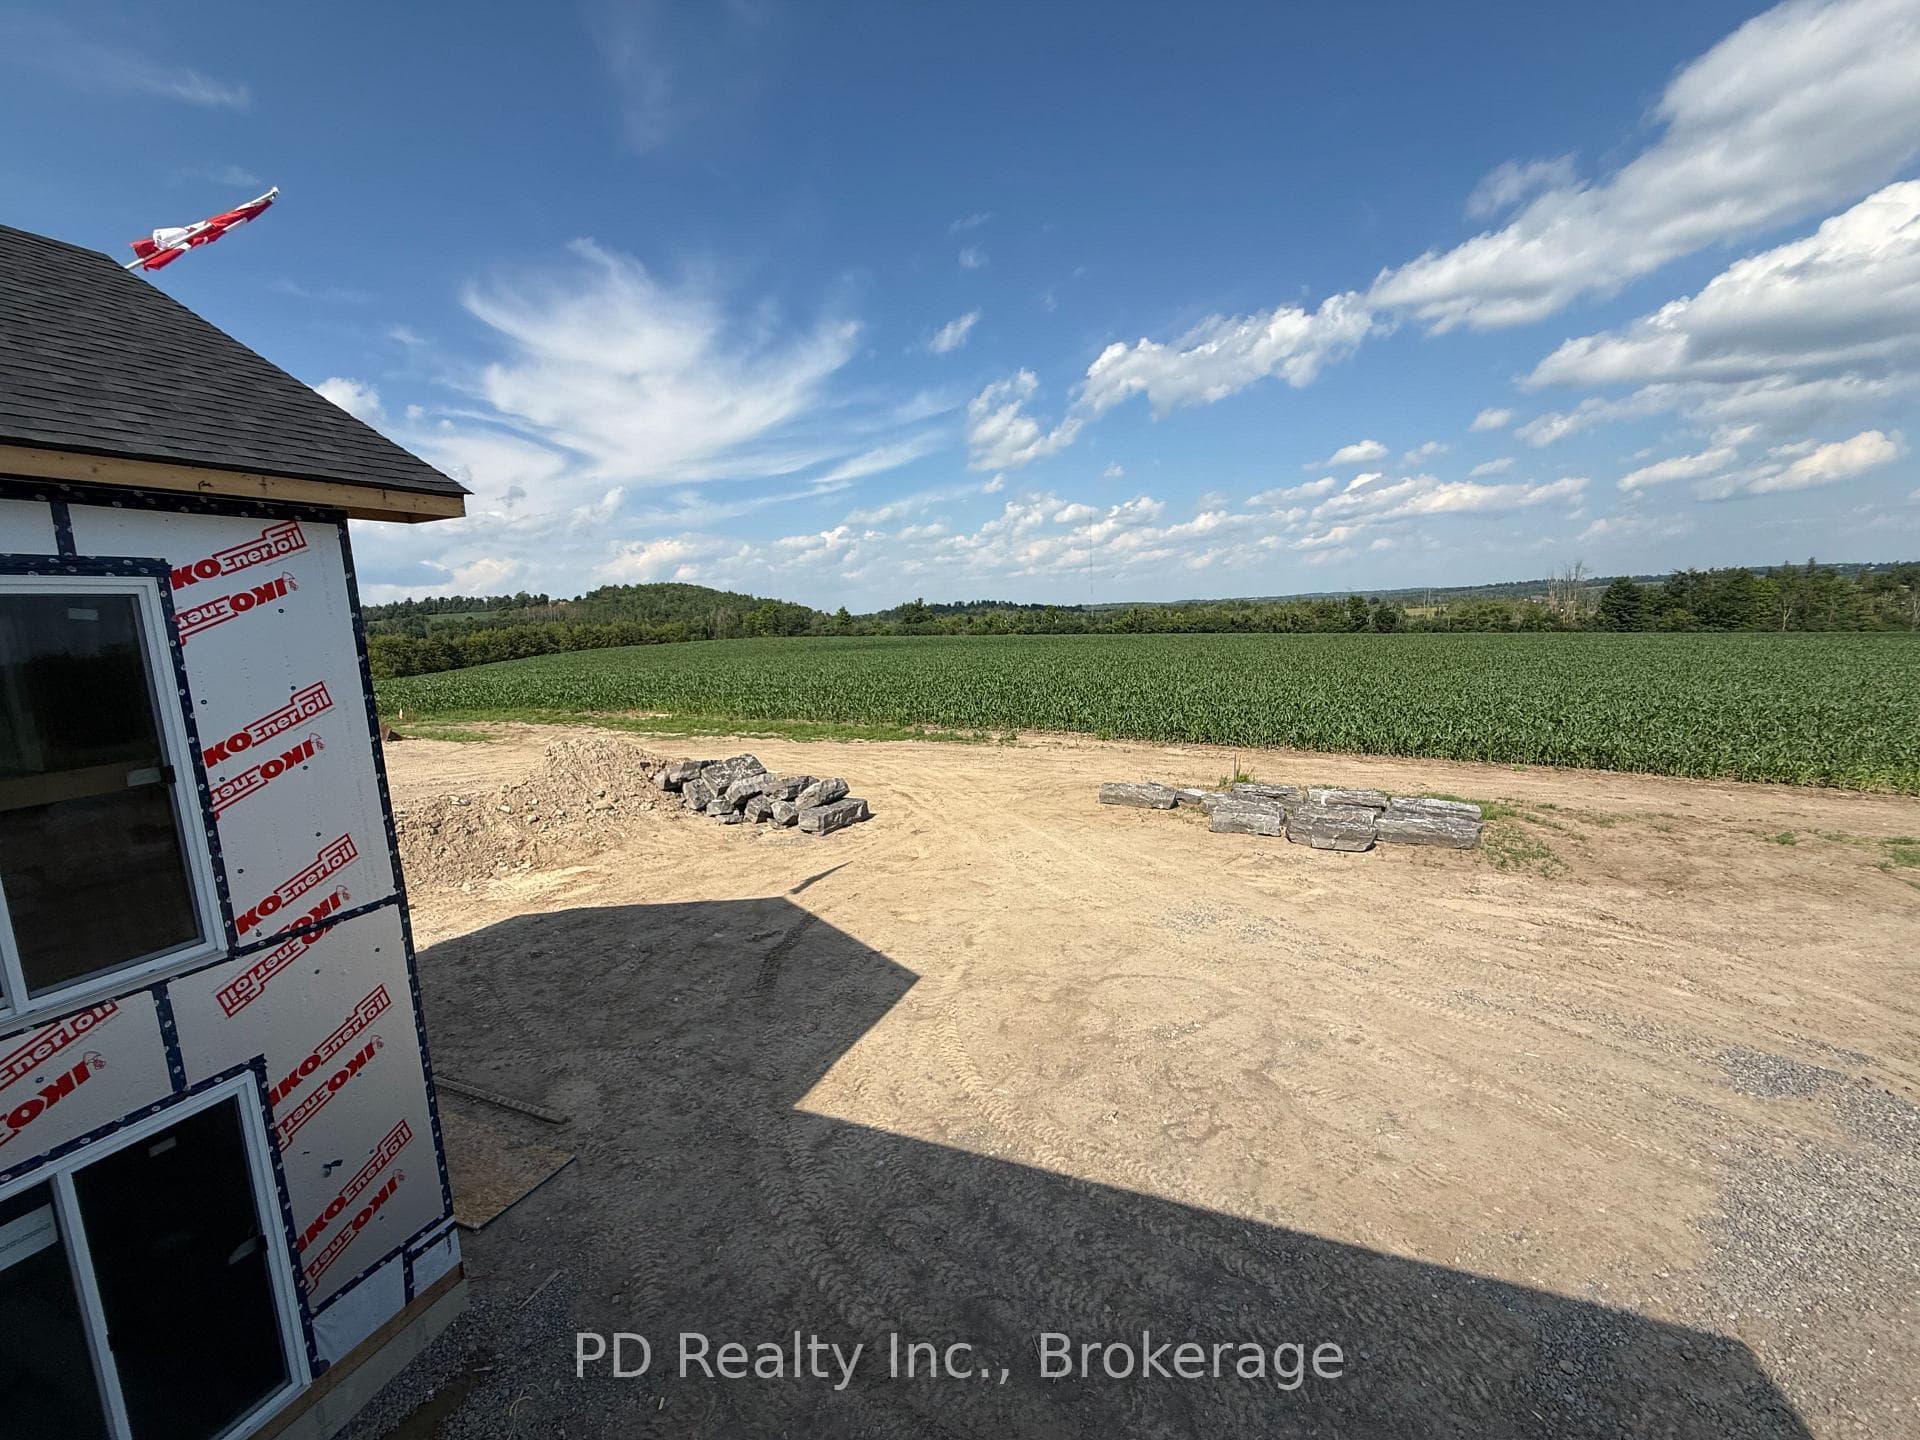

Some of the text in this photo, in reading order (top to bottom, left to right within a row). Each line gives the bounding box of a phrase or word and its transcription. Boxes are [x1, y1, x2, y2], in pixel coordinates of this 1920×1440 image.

[170, 559, 222, 591] KO
[202, 732, 252, 768] KO
[235, 895, 283, 936] KO
